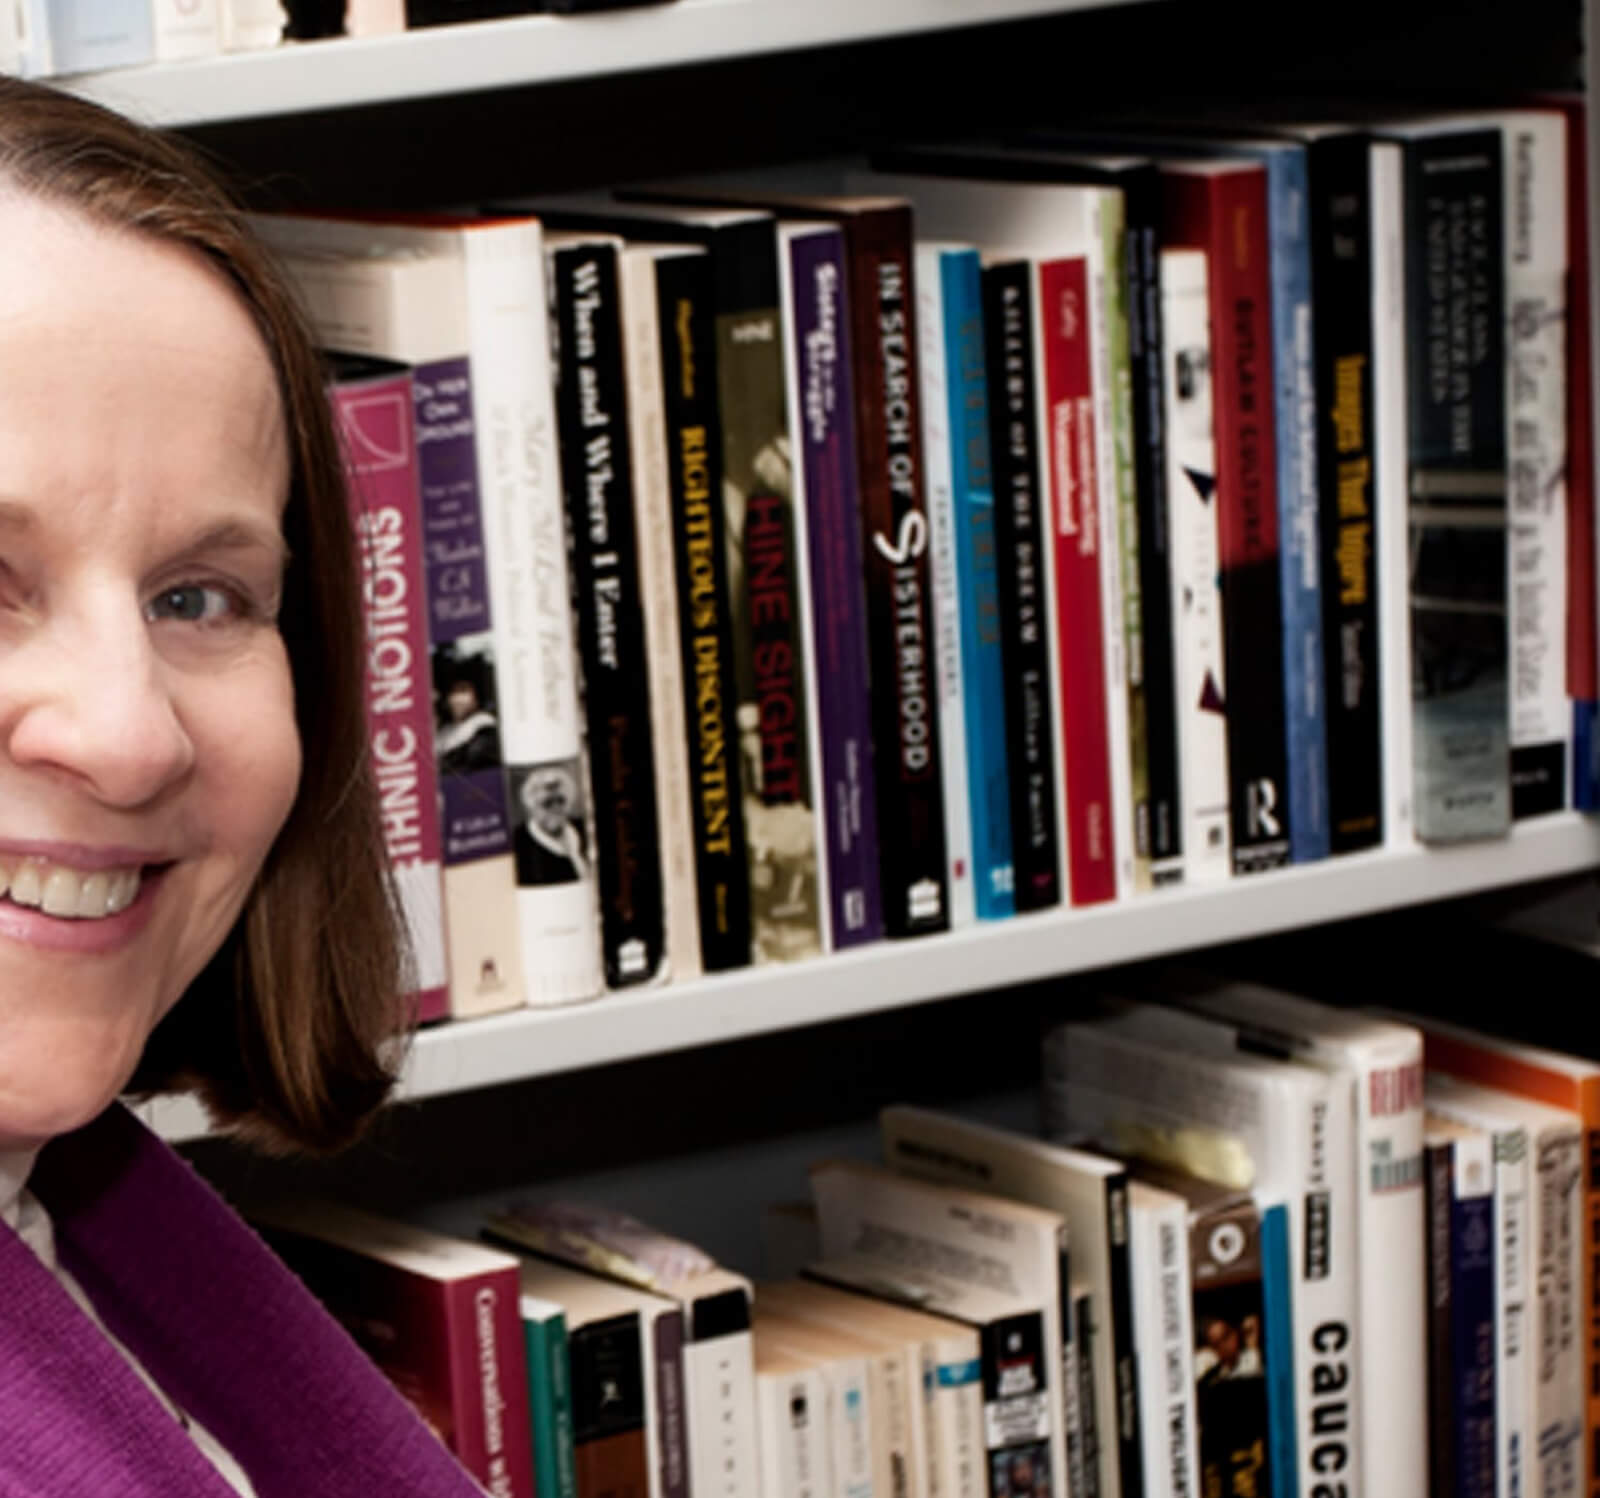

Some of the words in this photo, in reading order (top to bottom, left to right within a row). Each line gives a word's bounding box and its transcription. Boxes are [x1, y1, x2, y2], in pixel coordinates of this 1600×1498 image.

[573, 260, 602, 359] When
[877, 262, 902, 301] IN
[578, 365, 610, 427] and
[879, 311, 911, 445] SEARCH
[1332, 352, 1366, 454] Images
[586, 434, 614, 545] Where
[680, 424, 718, 627] RIGHTEOUS
[887, 453, 914, 496] OF
[1013, 474, 1032, 529] THE
[1336, 457, 1370, 519] That
[358, 505, 413, 715] NOTIONS
[750, 494, 791, 626] HINE
[594, 577, 621, 671] Enter
[872, 509, 929, 770] SISTERHOOD
[692, 635, 731, 857] DISCONTENT
[753, 639, 801, 807] SIGHT
[476, 1287, 507, 1454] Conversations
